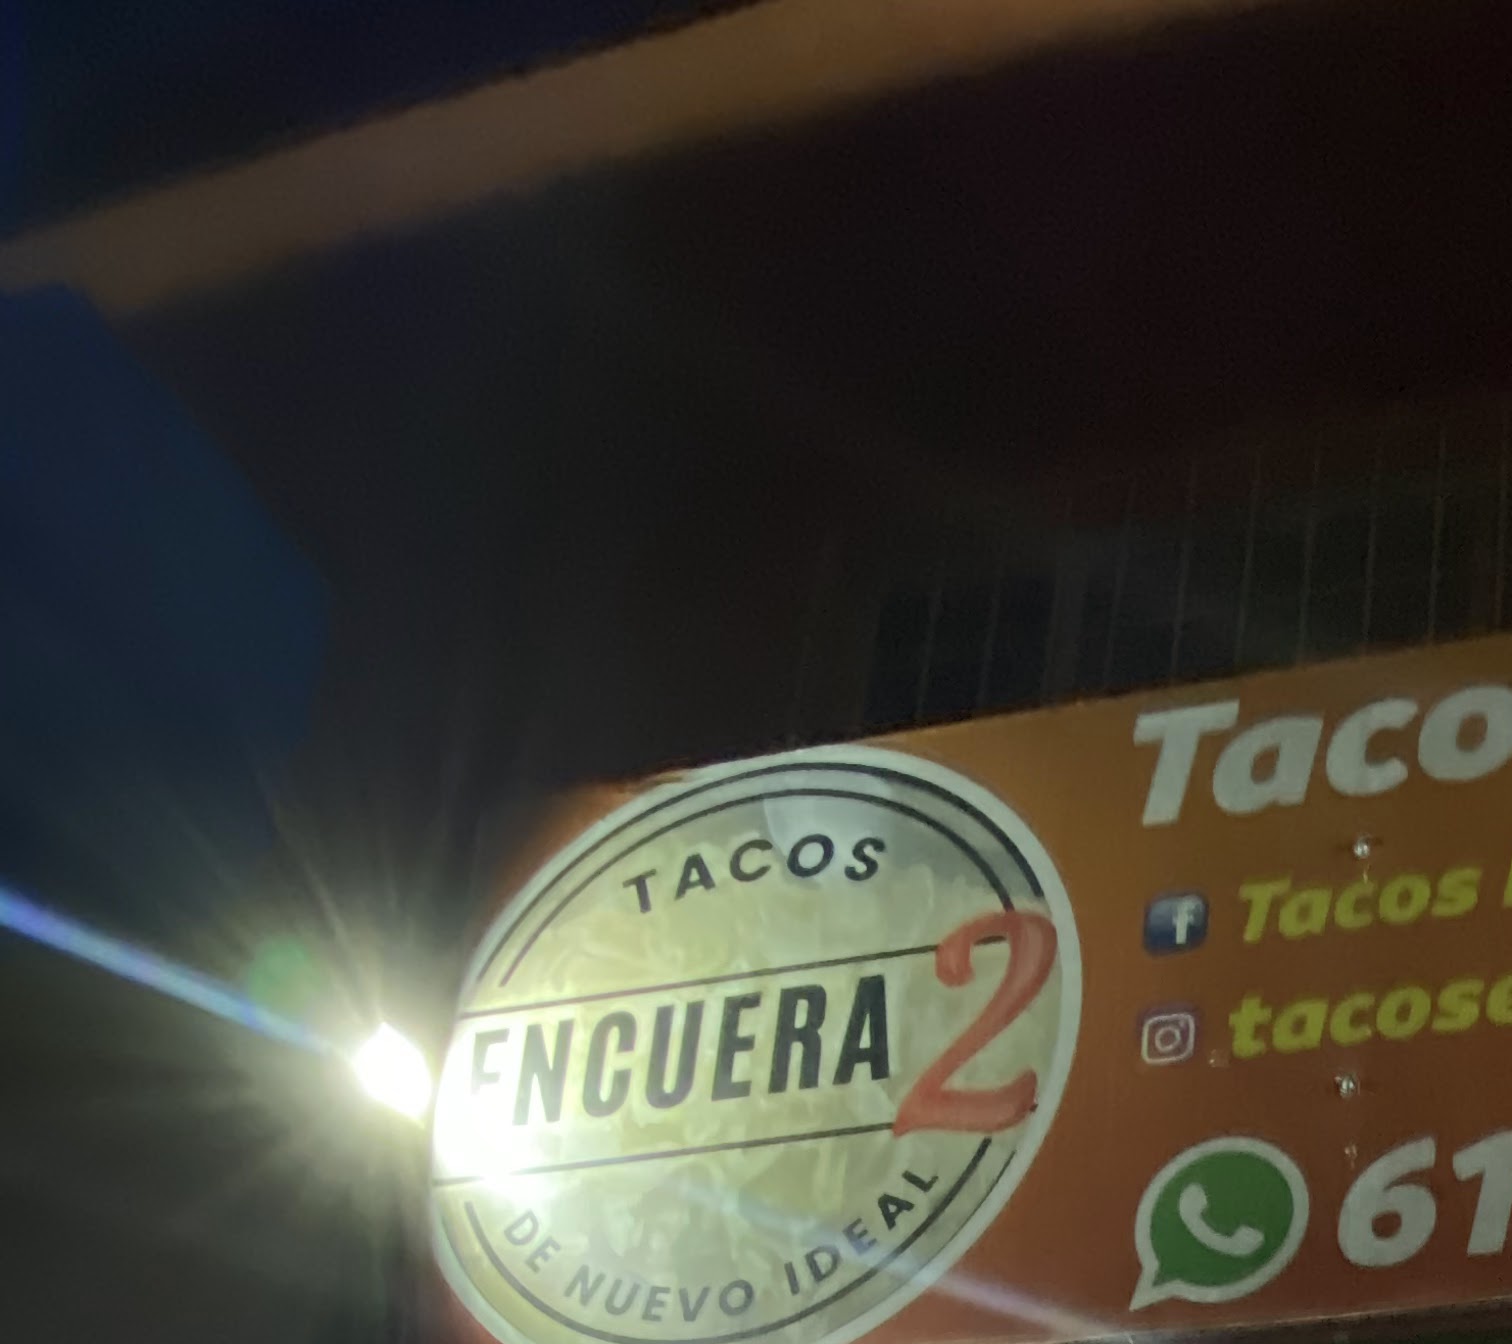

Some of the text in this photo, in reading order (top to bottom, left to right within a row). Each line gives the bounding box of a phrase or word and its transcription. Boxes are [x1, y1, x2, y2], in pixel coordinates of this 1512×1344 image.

[622, 834, 887, 913] TACOS
[1239, 865, 1483, 944] Tacos
[467, 911, 1057, 1138] ENCUERA 2
[502, 1166, 939, 1323] DE NUEVO IDEAL
